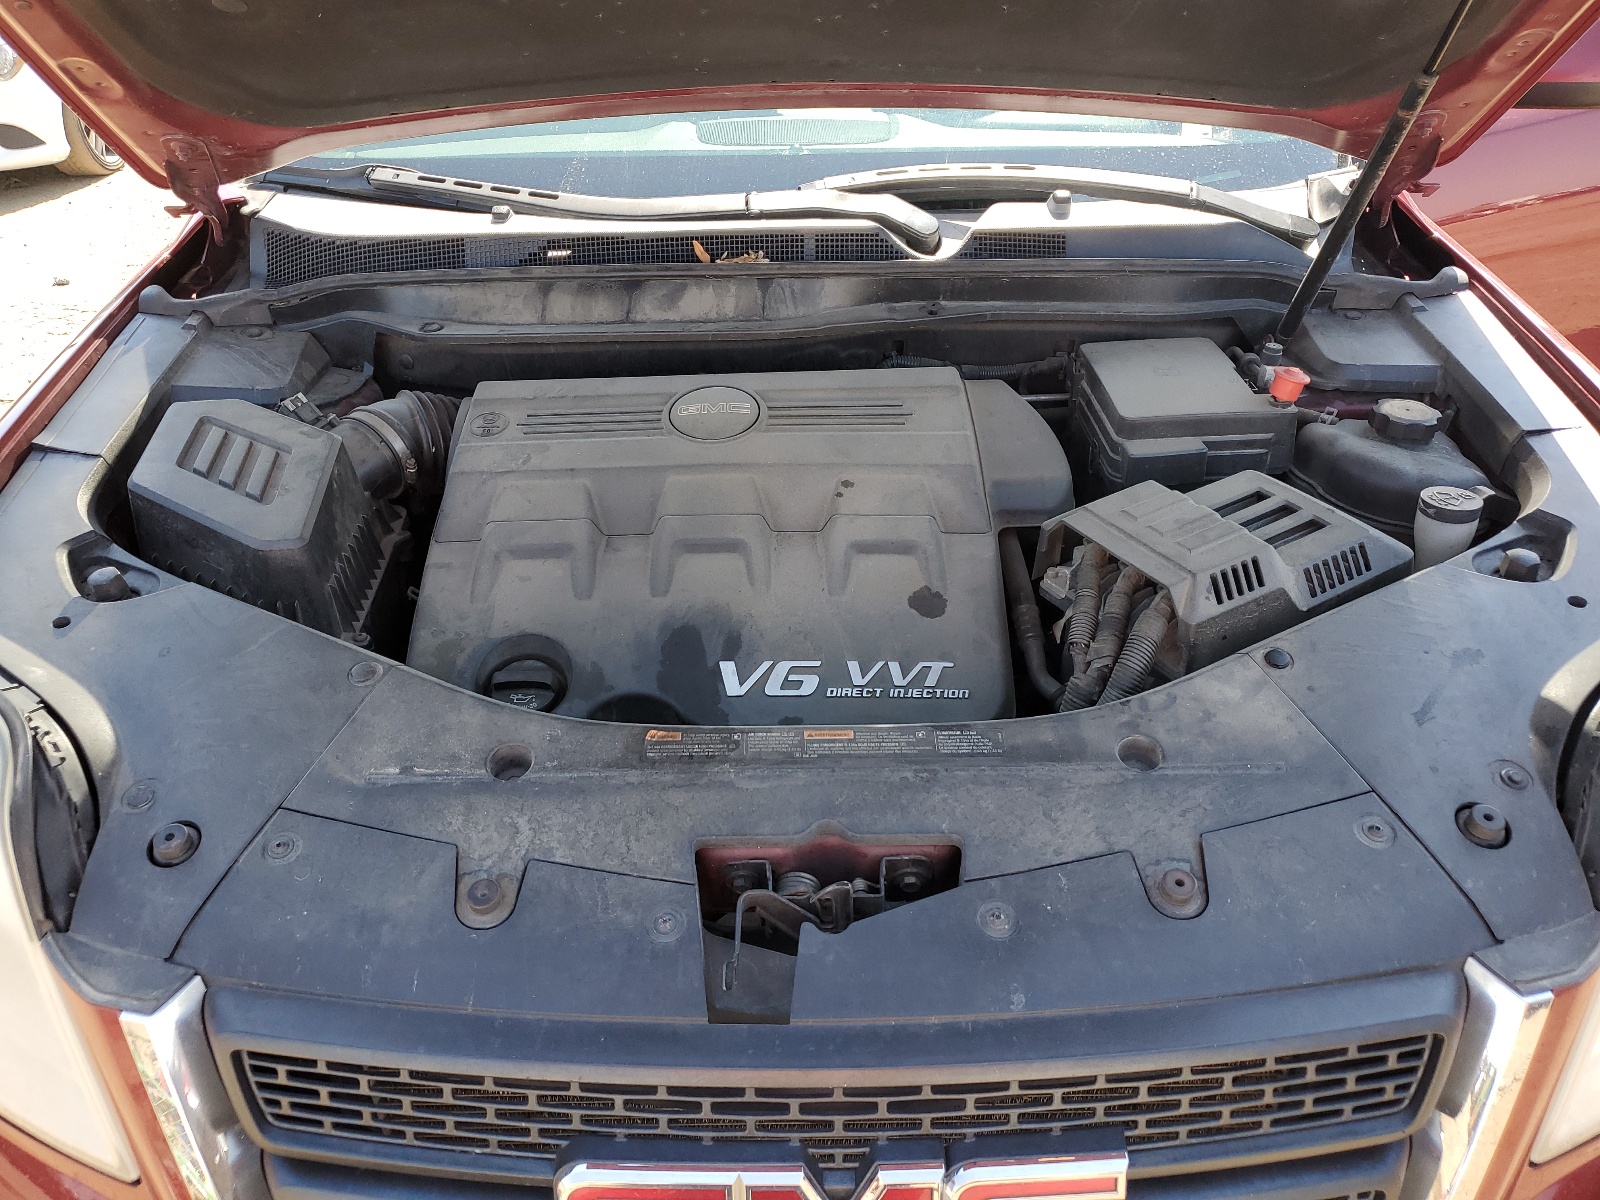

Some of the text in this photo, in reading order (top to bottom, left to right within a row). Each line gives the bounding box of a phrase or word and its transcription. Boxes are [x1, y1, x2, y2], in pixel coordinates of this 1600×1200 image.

[677, 402, 751, 416] GMC
[718, 660, 955, 697] V6 VVT
[826, 687, 970, 699] DIRECT INJECTION
